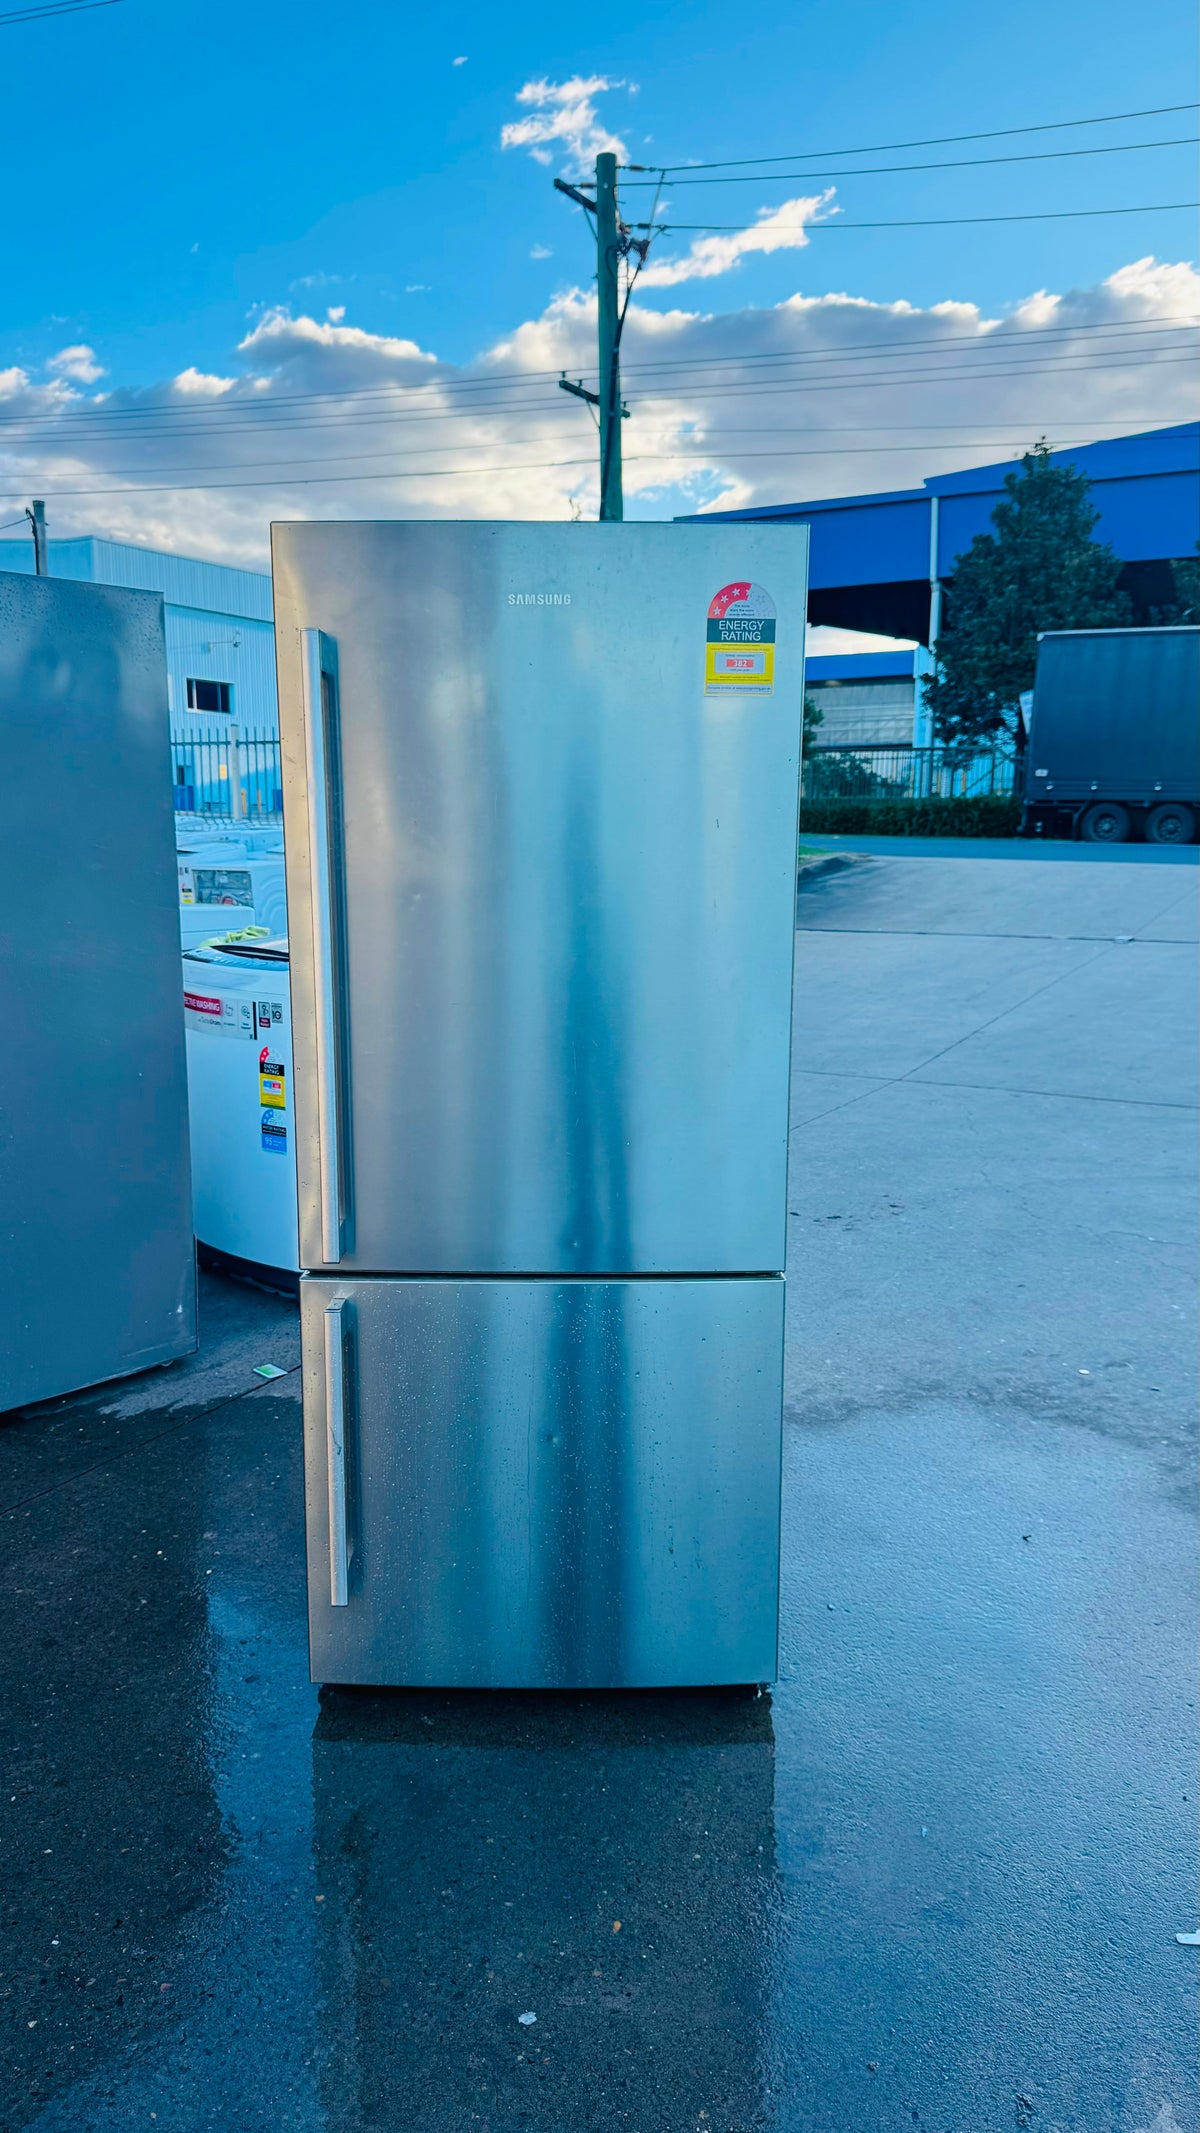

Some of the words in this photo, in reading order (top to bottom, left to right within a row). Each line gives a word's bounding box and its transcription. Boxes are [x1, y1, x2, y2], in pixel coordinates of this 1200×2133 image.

[508, 593, 572, 606] SAMSUNG
[718, 620, 765, 631] ENERGY
[721, 631, 761, 641] RATING
